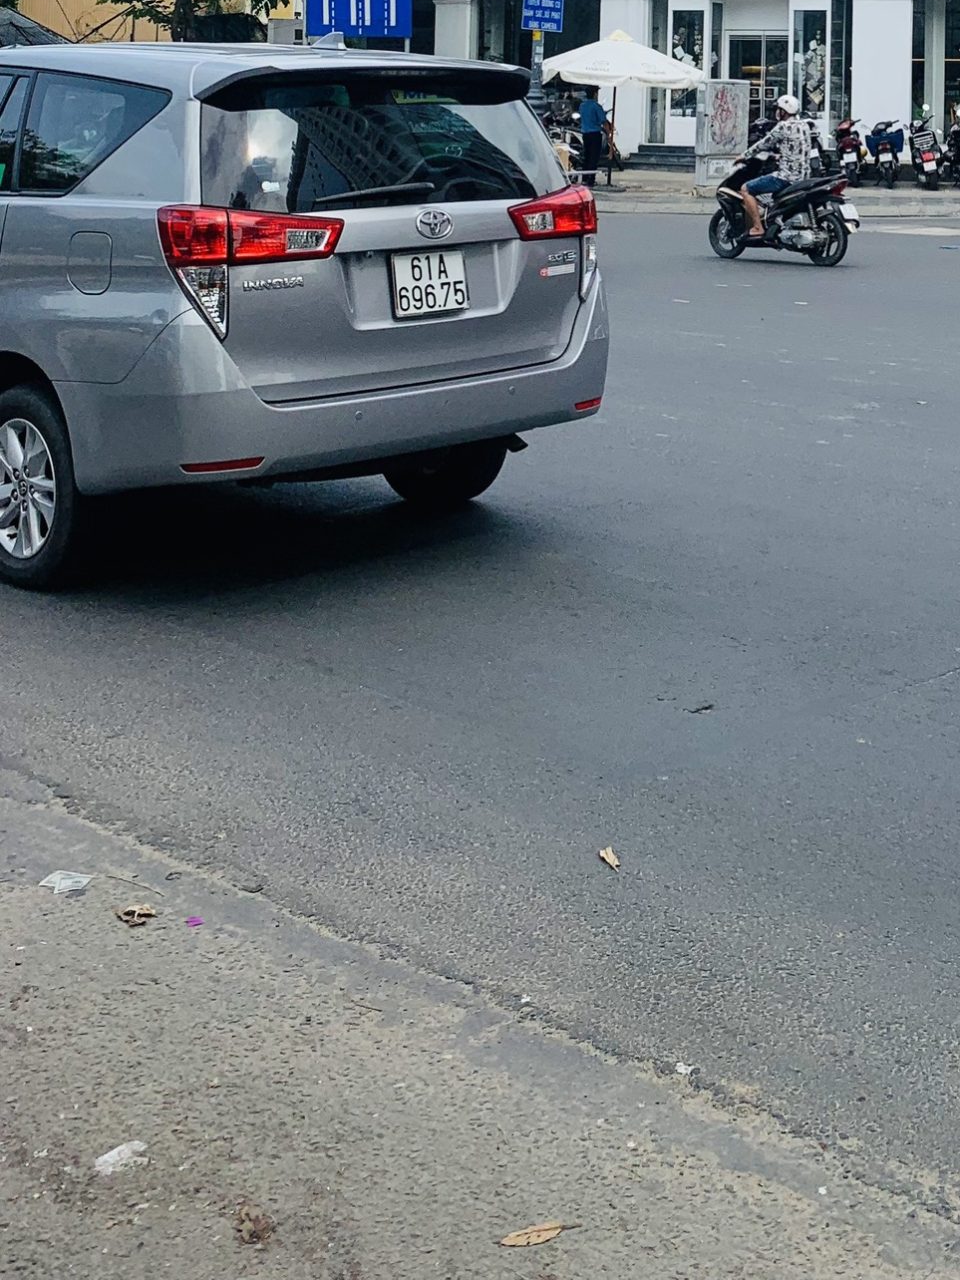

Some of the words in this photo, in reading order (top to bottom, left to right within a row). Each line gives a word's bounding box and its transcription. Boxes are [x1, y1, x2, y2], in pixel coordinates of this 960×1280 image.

[411, 253, 448, 282] 61A
[242, 276, 304, 292] INNOVA
[399, 280, 466, 312] 696.75
